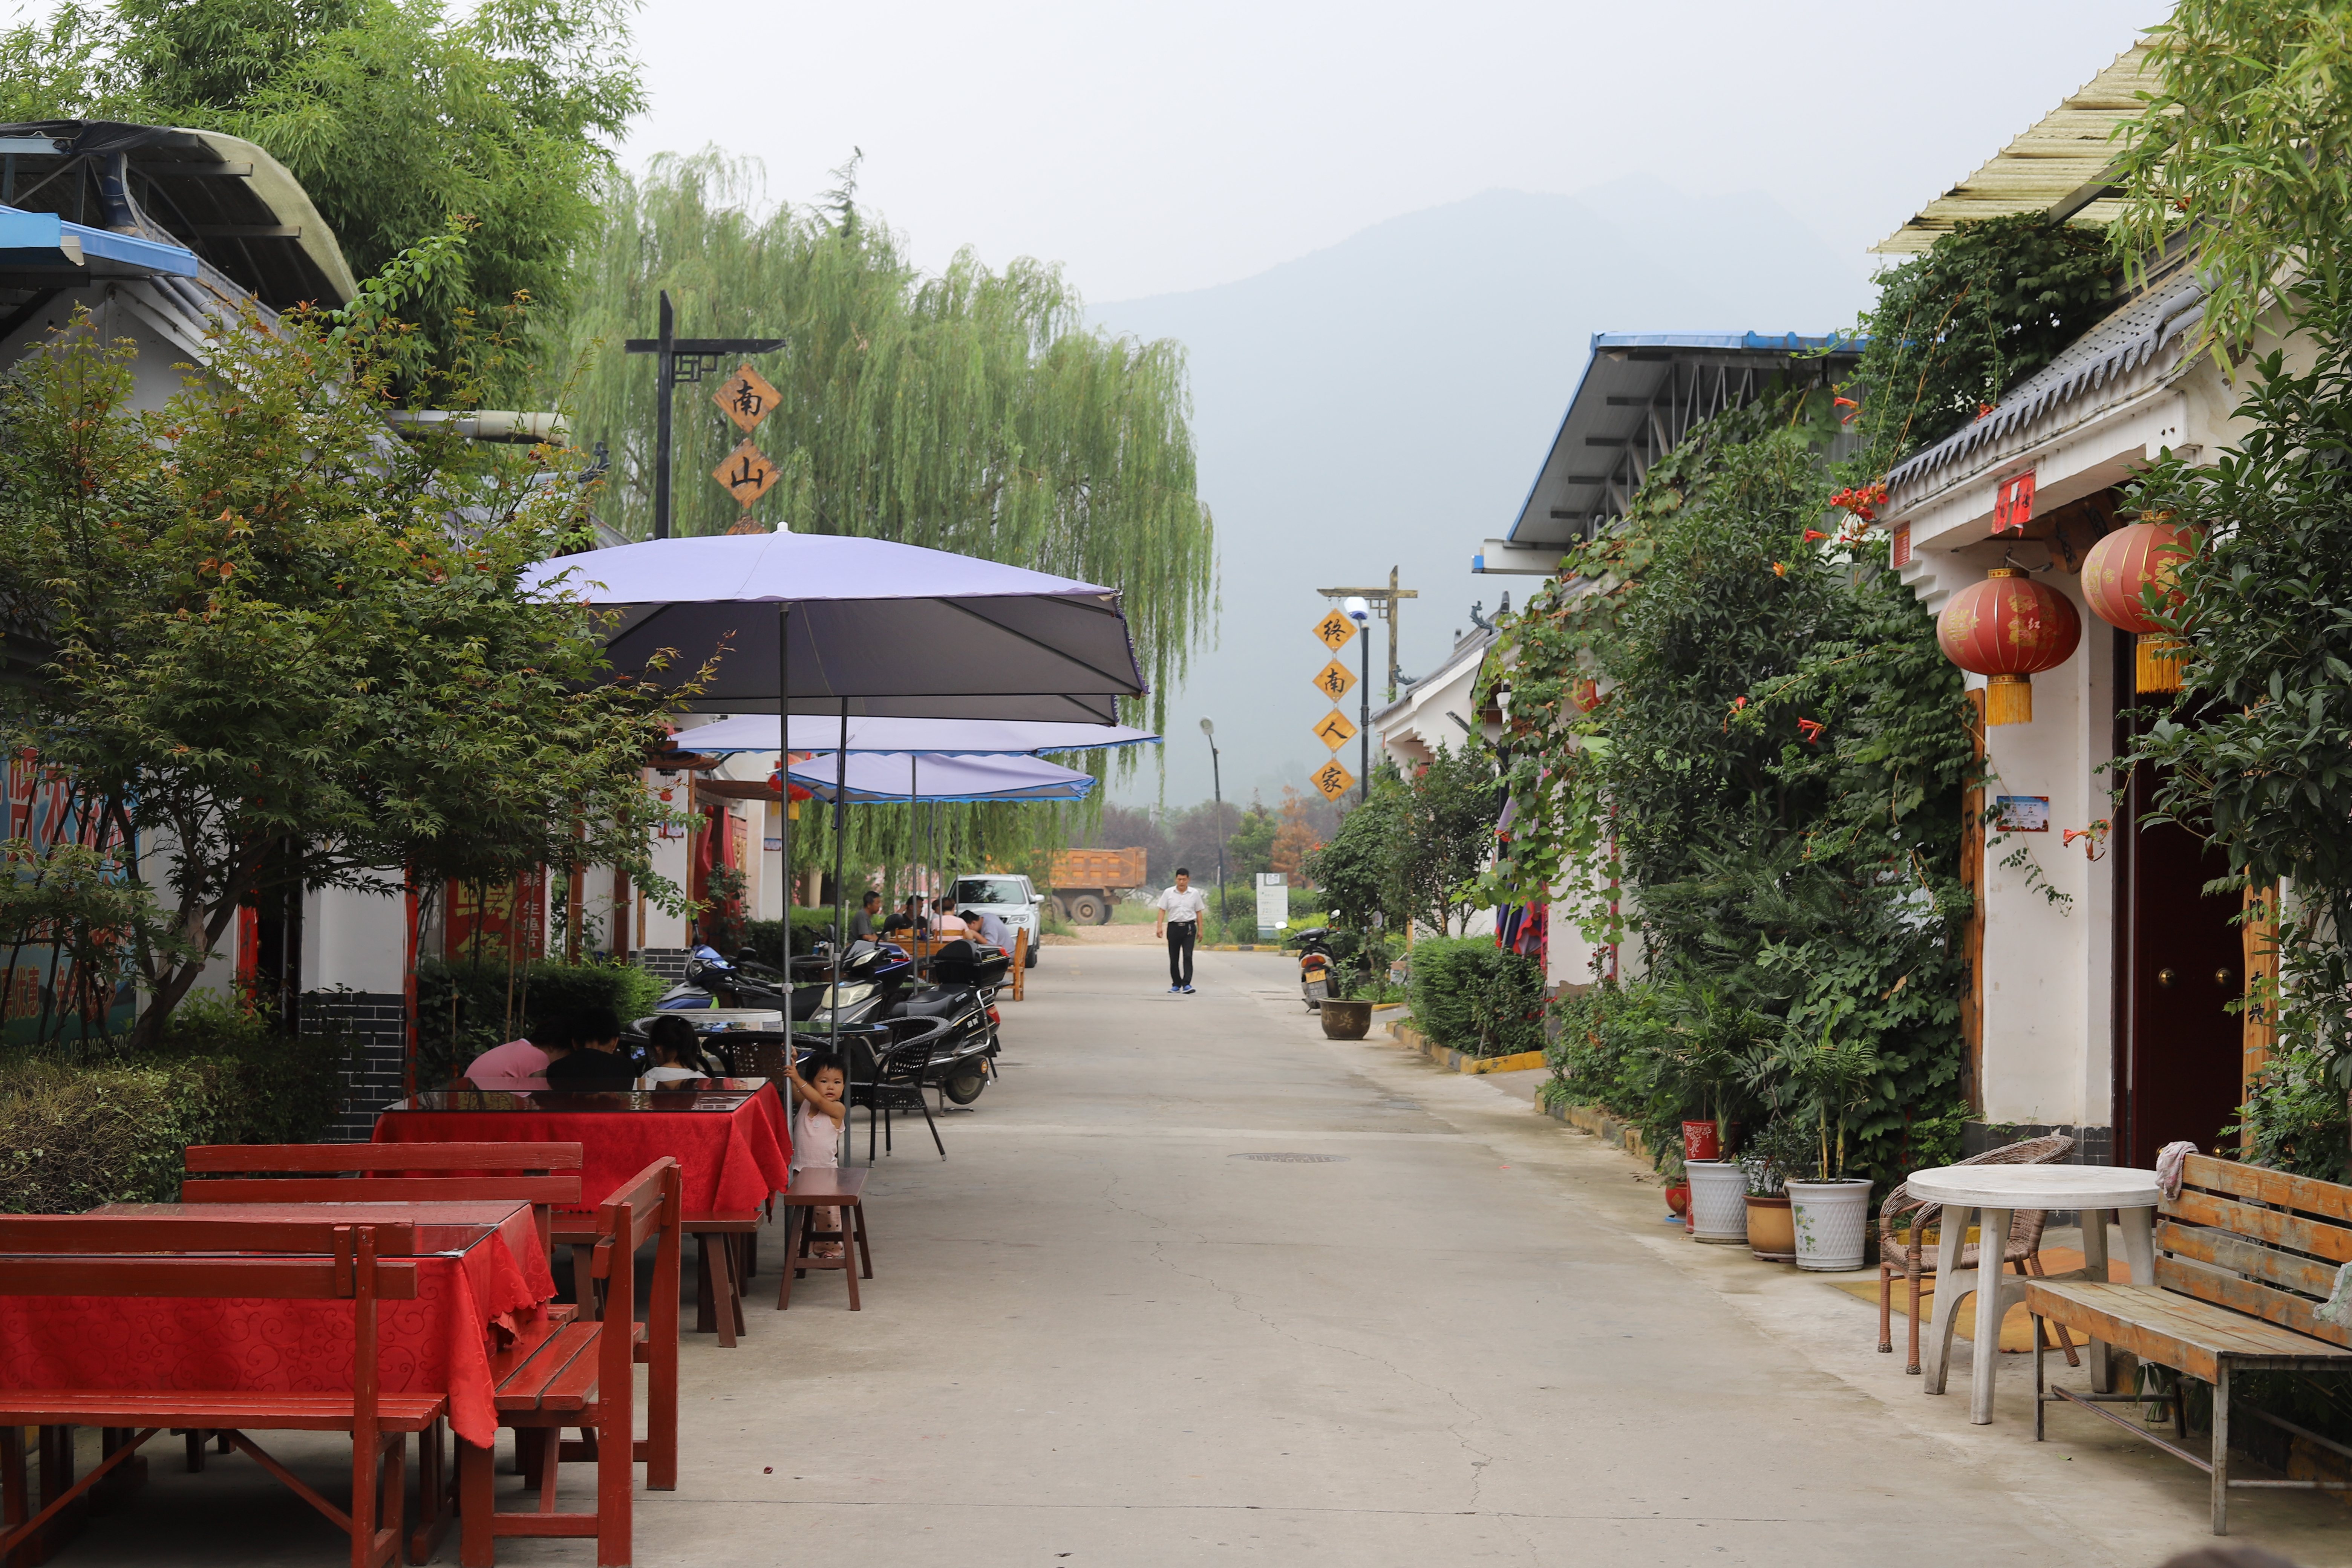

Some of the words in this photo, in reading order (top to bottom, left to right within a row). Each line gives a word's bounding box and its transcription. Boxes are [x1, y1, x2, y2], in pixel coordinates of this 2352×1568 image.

[731, 379, 764, 489] 南山
[1321, 619, 1348, 793] 终南人家
